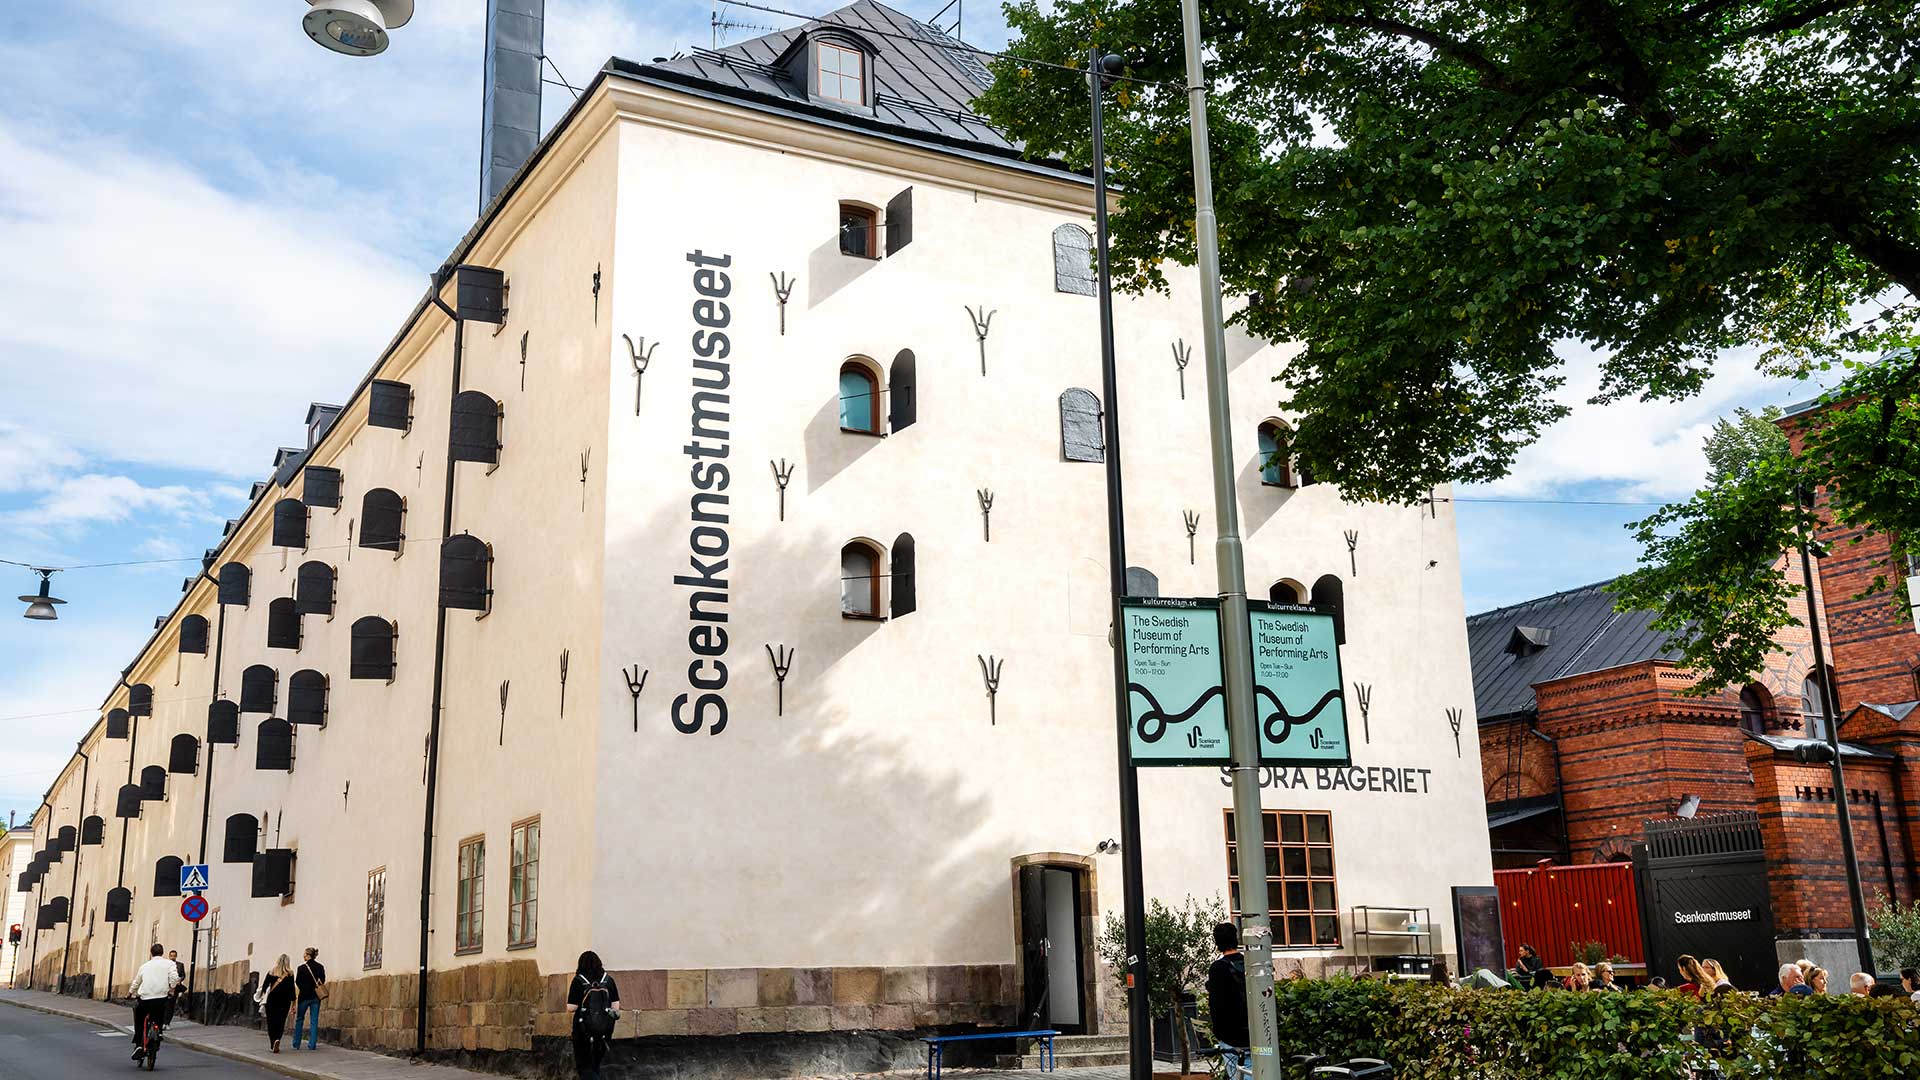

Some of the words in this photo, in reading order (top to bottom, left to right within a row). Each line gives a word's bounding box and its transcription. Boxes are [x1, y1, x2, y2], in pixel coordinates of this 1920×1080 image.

[671, 249, 732, 736] Scenkonstmuseet
[1142, 597, 1197, 608] kulturreklam.se
[1267, 602, 1316, 613] kulturreklam.se
[1132, 614, 1150, 626] The
[1151, 615, 1189, 628] Swedish
[1258, 618, 1274, 631] The
[1275, 619, 1309, 632] Swedish
[1133, 628, 1171, 641] Museum
[1173, 630, 1182, 641] of
[1258, 632, 1294, 645] Museum
[1295, 634, 1303, 645] of
[1133, 642, 1188, 658] Performing
[1188, 643, 1210, 656] Arts
[1259, 645, 1309, 661] Performing
[1309, 647, 1329, 660] Arts
[1220, 766, 1309, 790] SORA
[1316, 766, 1431, 794] BAGERIET
[1674, 909, 1751, 924] Scenkonstmuseet
